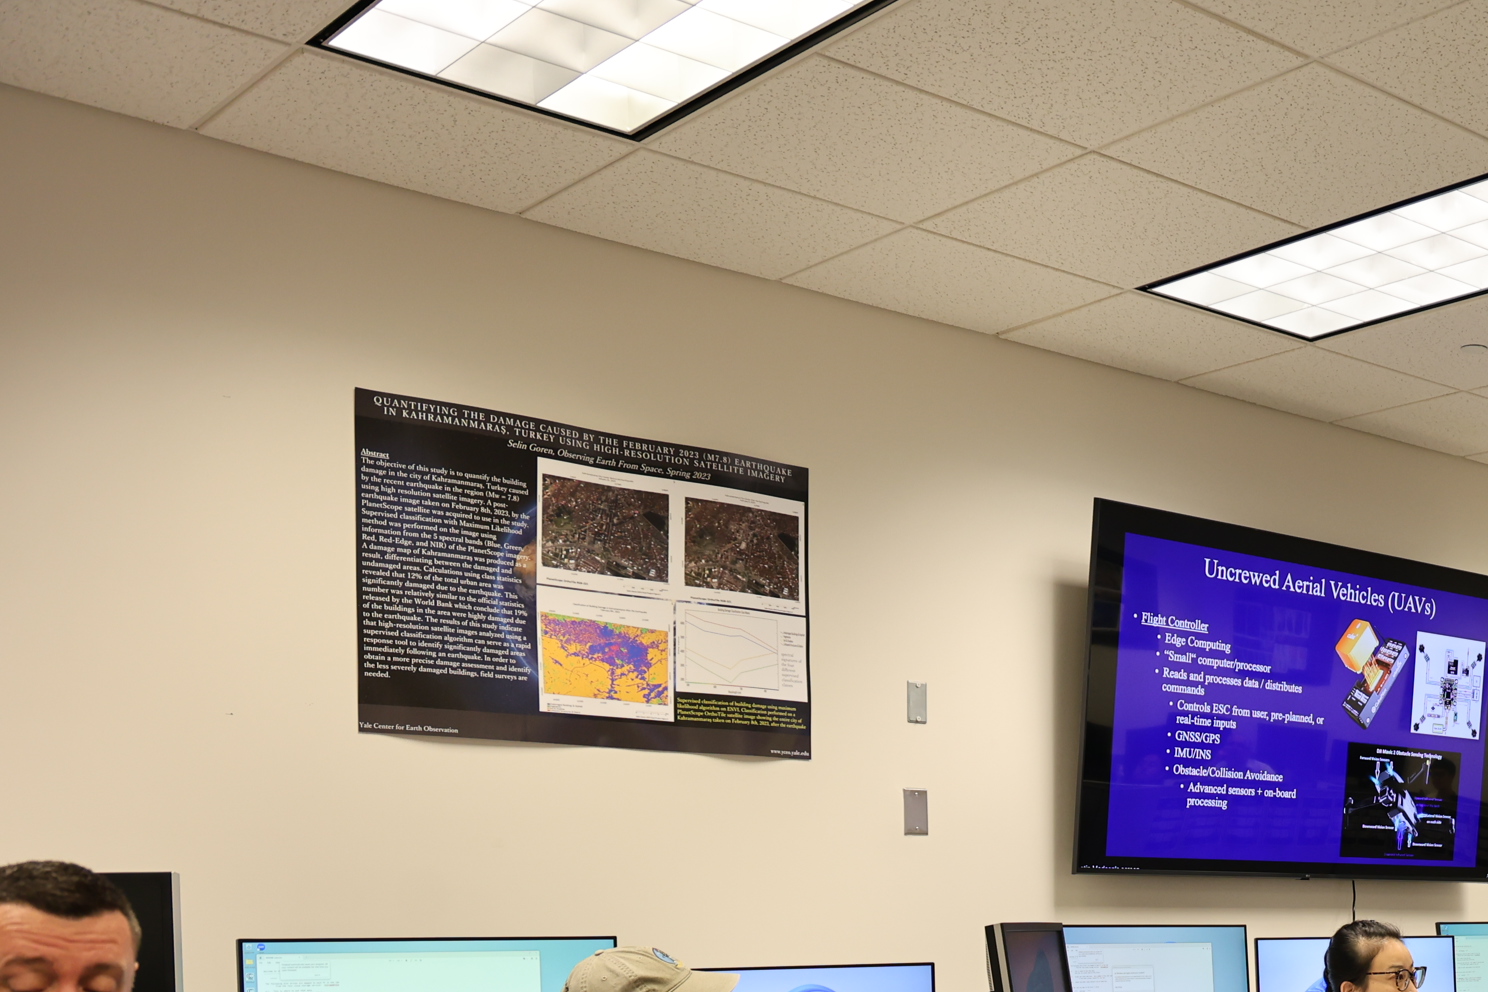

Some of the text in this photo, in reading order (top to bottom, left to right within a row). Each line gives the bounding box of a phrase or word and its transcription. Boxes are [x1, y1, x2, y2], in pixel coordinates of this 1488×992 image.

[373, 395, 792, 477] QUANTIFYING THE DAMAGE CAUSED BY THE FEBRUARY 2023 (M7.8) EARTHQUAKE
[384, 407, 397, 416] IN
[514, 428, 555, 443] TURKEY
[559, 437, 590, 450] USING
[594, 444, 689, 466] HIGH-RESOLUTION
[694, 460, 744, 475] SATELLITE
[748, 469, 786, 483] IMAGERY
[361, 448, 389, 460] Abstract
[507, 439, 528, 450] Selin
[557, 448, 595, 465] Observing
[596, 456, 617, 467] Earth
[618, 460, 639, 470] From
[666, 467, 691, 480] Spring
[692, 471, 711, 481] 2023
[361, 456, 375, 465] The
[376, 459, 407, 469] objective
[416, 464, 429, 472] this
[430, 467, 448, 477] study
[464, 473, 490, 483] quantify
[502, 477, 527, 489] building
[361, 464, 387, 476] damage
[388, 468, 396, 476] in
[409, 472, 422, 482] city
[487, 483, 508, 494] Turkey
[361, 473, 369, 483] by
[383, 478, 405, 486] recent
[406, 481, 443, 491] earthquake
[452, 486, 463, 494] the
[464, 489, 484, 497] region
[508, 494, 520, 504] 7.8)
[361, 483, 380, 492] using
[380, 484, 396, 494] high
[397, 488, 431, 497] resolution
[432, 492, 458, 501] satellite
[361, 492, 399, 502] earthquake
[400, 496, 421, 506] image
[421, 499, 440, 507] taken
[451, 503, 479, 515] February
[511, 511, 519, 520] by
[520, 512, 530, 520] the
[361, 499, 403, 512] PlanetScope
[404, 506, 431, 514] satellite
[445, 512, 473, 520] acquired
[361, 507, 398, 518] Supervised
[399, 513, 443, 524] classification
[459, 520, 490, 531] Maximum
[491, 525, 523, 535] Likelihood
[1202, 557, 1437, 620] Uncrewed Aerial Vehicles (UAVs)
[1141, 612, 1209, 633] Flight Controller
[1165, 633, 1231, 655] Edge Computing
[1197, 658, 1272, 674] computer/processor
[1162, 685, 1205, 696] commands
[1163, 667, 1188, 680] Reads
[1189, 672, 1205, 682] and
[1205, 675, 1242, 686] processes
[1243, 677, 1260, 689] data
[1264, 680, 1303, 694] distributes
[1177, 700, 1212, 713] Controls
[1212, 704, 1231, 715] ESC
[1232, 706, 1251, 717] from
[423, 726, 459, 734] Observation
[1176, 715, 1237, 731] real-time inputs
[1175, 731, 1221, 745] GNSS/GPS
[1174, 748, 1212, 760] IMU/INS
[1173, 764, 1284, 782] Obstacle/Collision Avoidance
[1188, 782, 1227, 794] Advanced
[1228, 788, 1256, 796] sensors
[1264, 788, 1297, 799] on-board
[1186, 798, 1228, 810] processing
